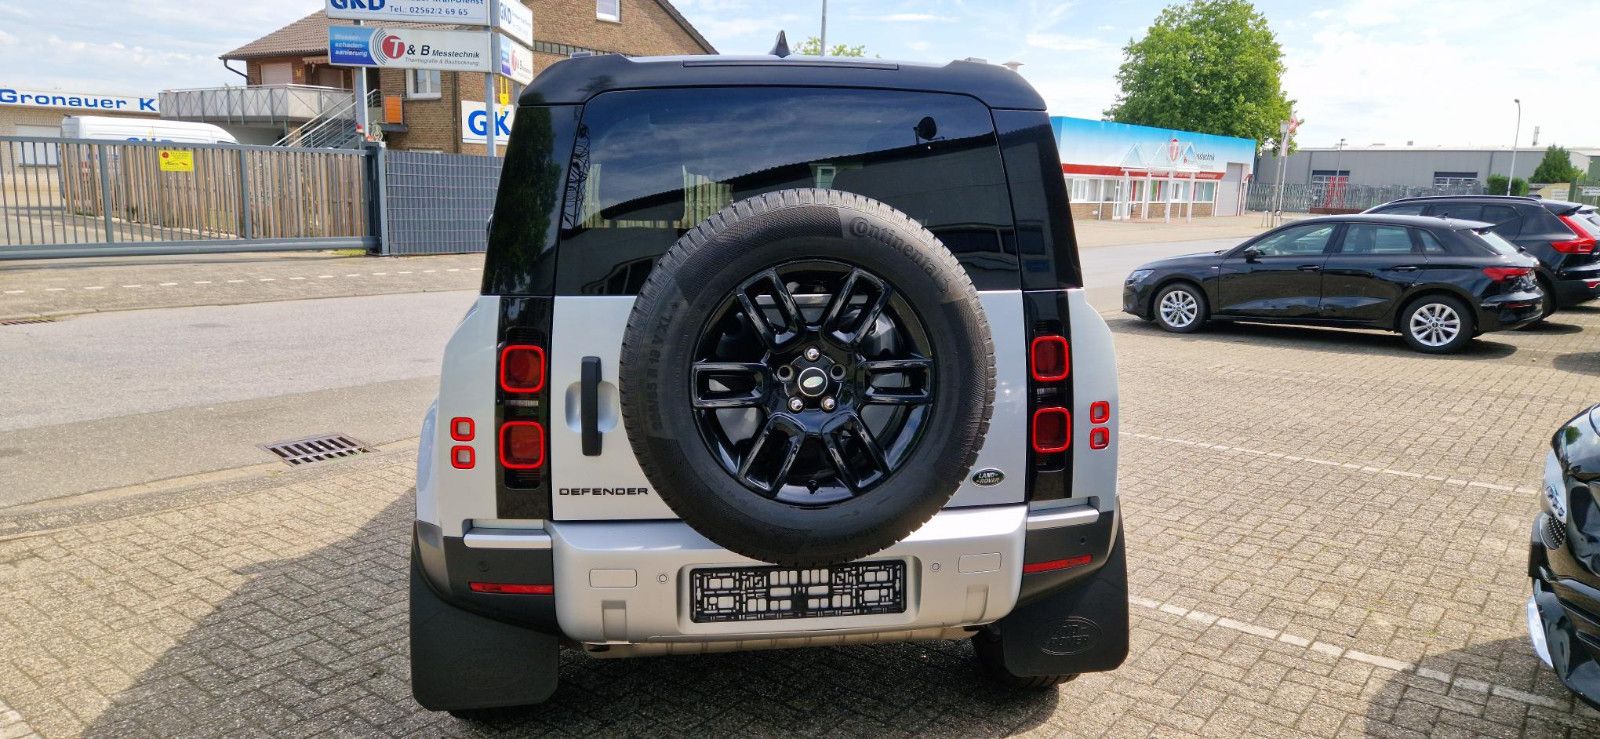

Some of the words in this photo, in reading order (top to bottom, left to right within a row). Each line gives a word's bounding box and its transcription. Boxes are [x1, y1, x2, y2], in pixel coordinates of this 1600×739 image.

[389, 38, 404, 57] T
[406, 44, 416, 56] &
[420, 44, 431, 56] B
[432, 49, 480, 58] Messtechnik
[0, 88, 127, 109] Gronauer
[559, 487, 649, 496] DEFENDER
